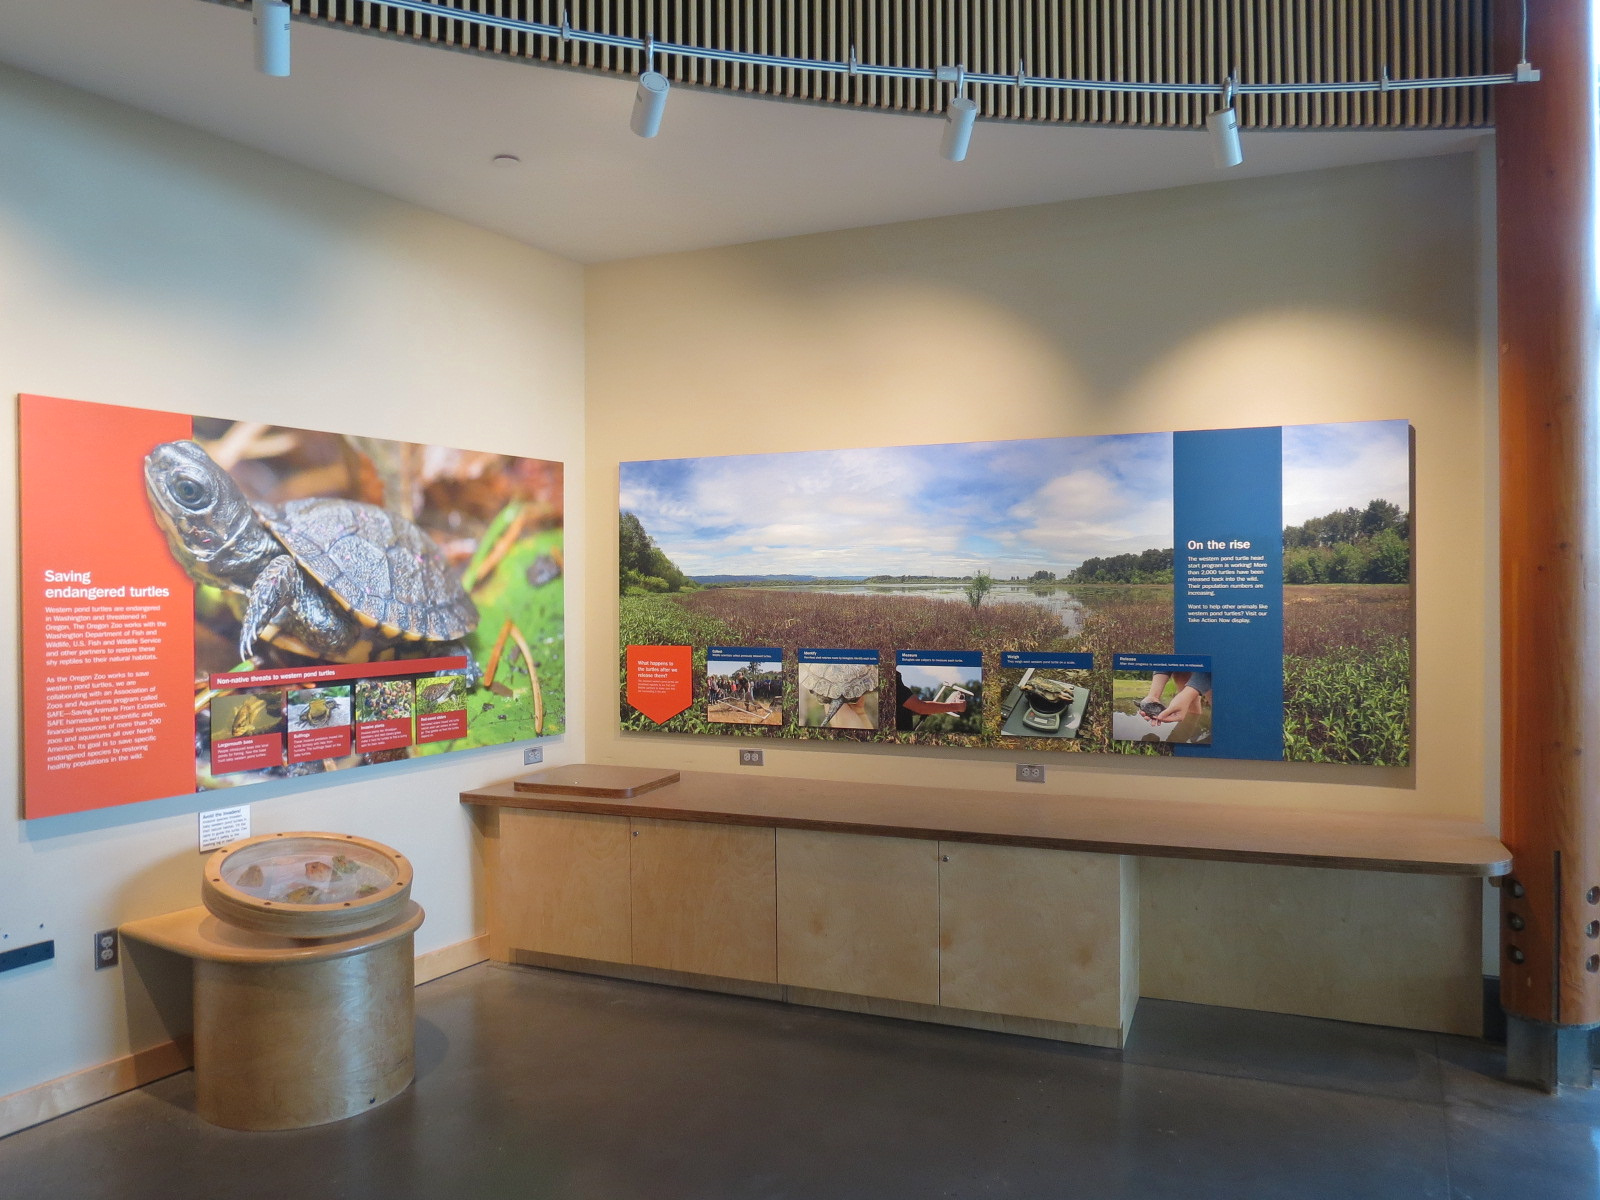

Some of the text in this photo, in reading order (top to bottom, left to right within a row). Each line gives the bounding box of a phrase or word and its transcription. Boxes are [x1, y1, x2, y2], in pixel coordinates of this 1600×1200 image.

[1188, 540, 1250, 549] On the rise
[45, 570, 91, 585] Saving
[45, 586, 169, 600] endangered turtles
[73, 758, 109, 768] populations
